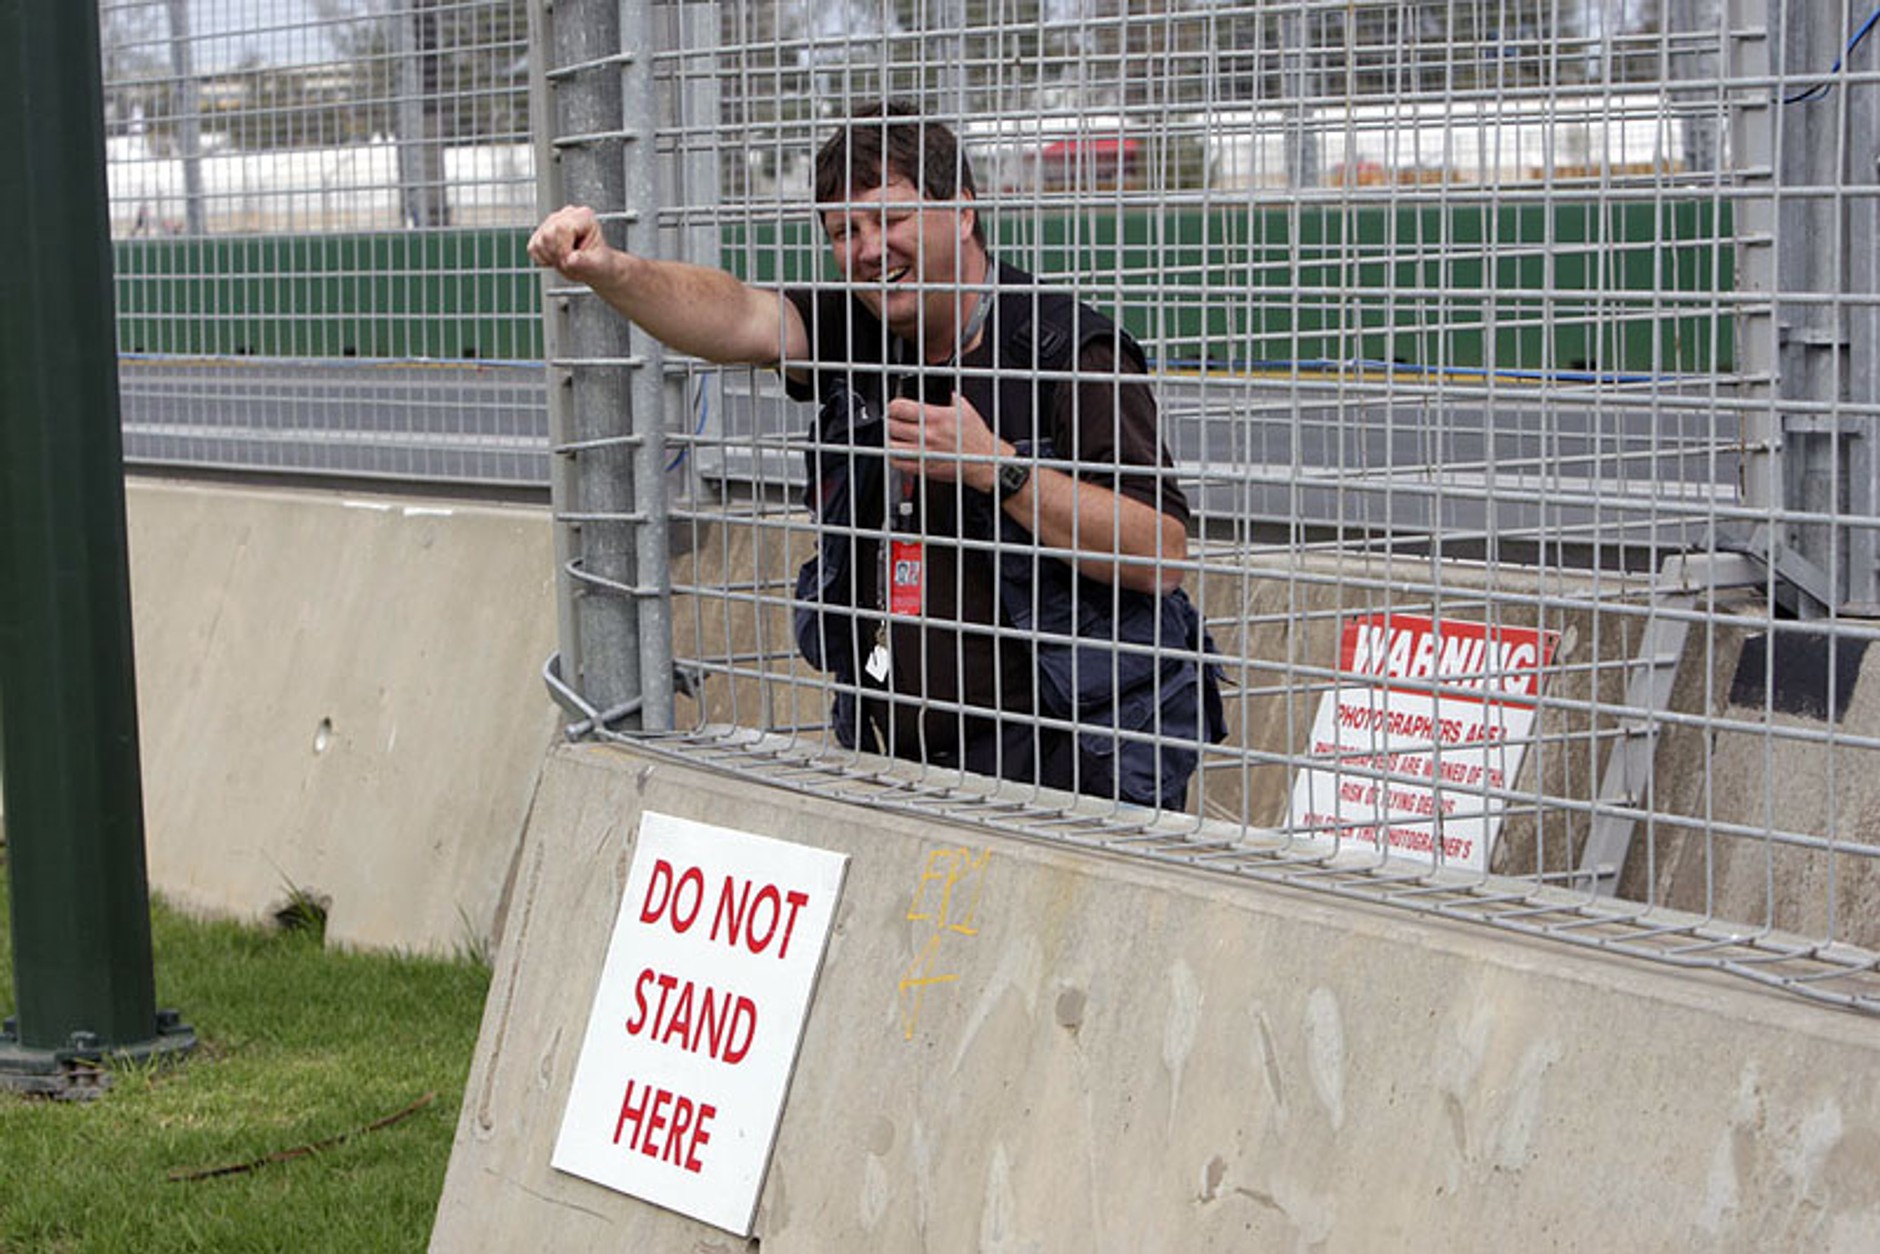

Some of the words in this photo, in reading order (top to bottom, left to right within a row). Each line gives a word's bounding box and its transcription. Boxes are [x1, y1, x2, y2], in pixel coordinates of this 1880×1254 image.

[1351, 623, 1536, 695] WARNING
[1381, 791, 1416, 812] LYING
[1423, 760, 1467, 783] WRNED
[1382, 828, 1474, 860] PHOTOGRAHER'S
[640, 859, 705, 934] DO
[710, 875, 809, 960] NOT
[626, 968, 758, 1065] STAND
[613, 1079, 717, 1173] HERE
